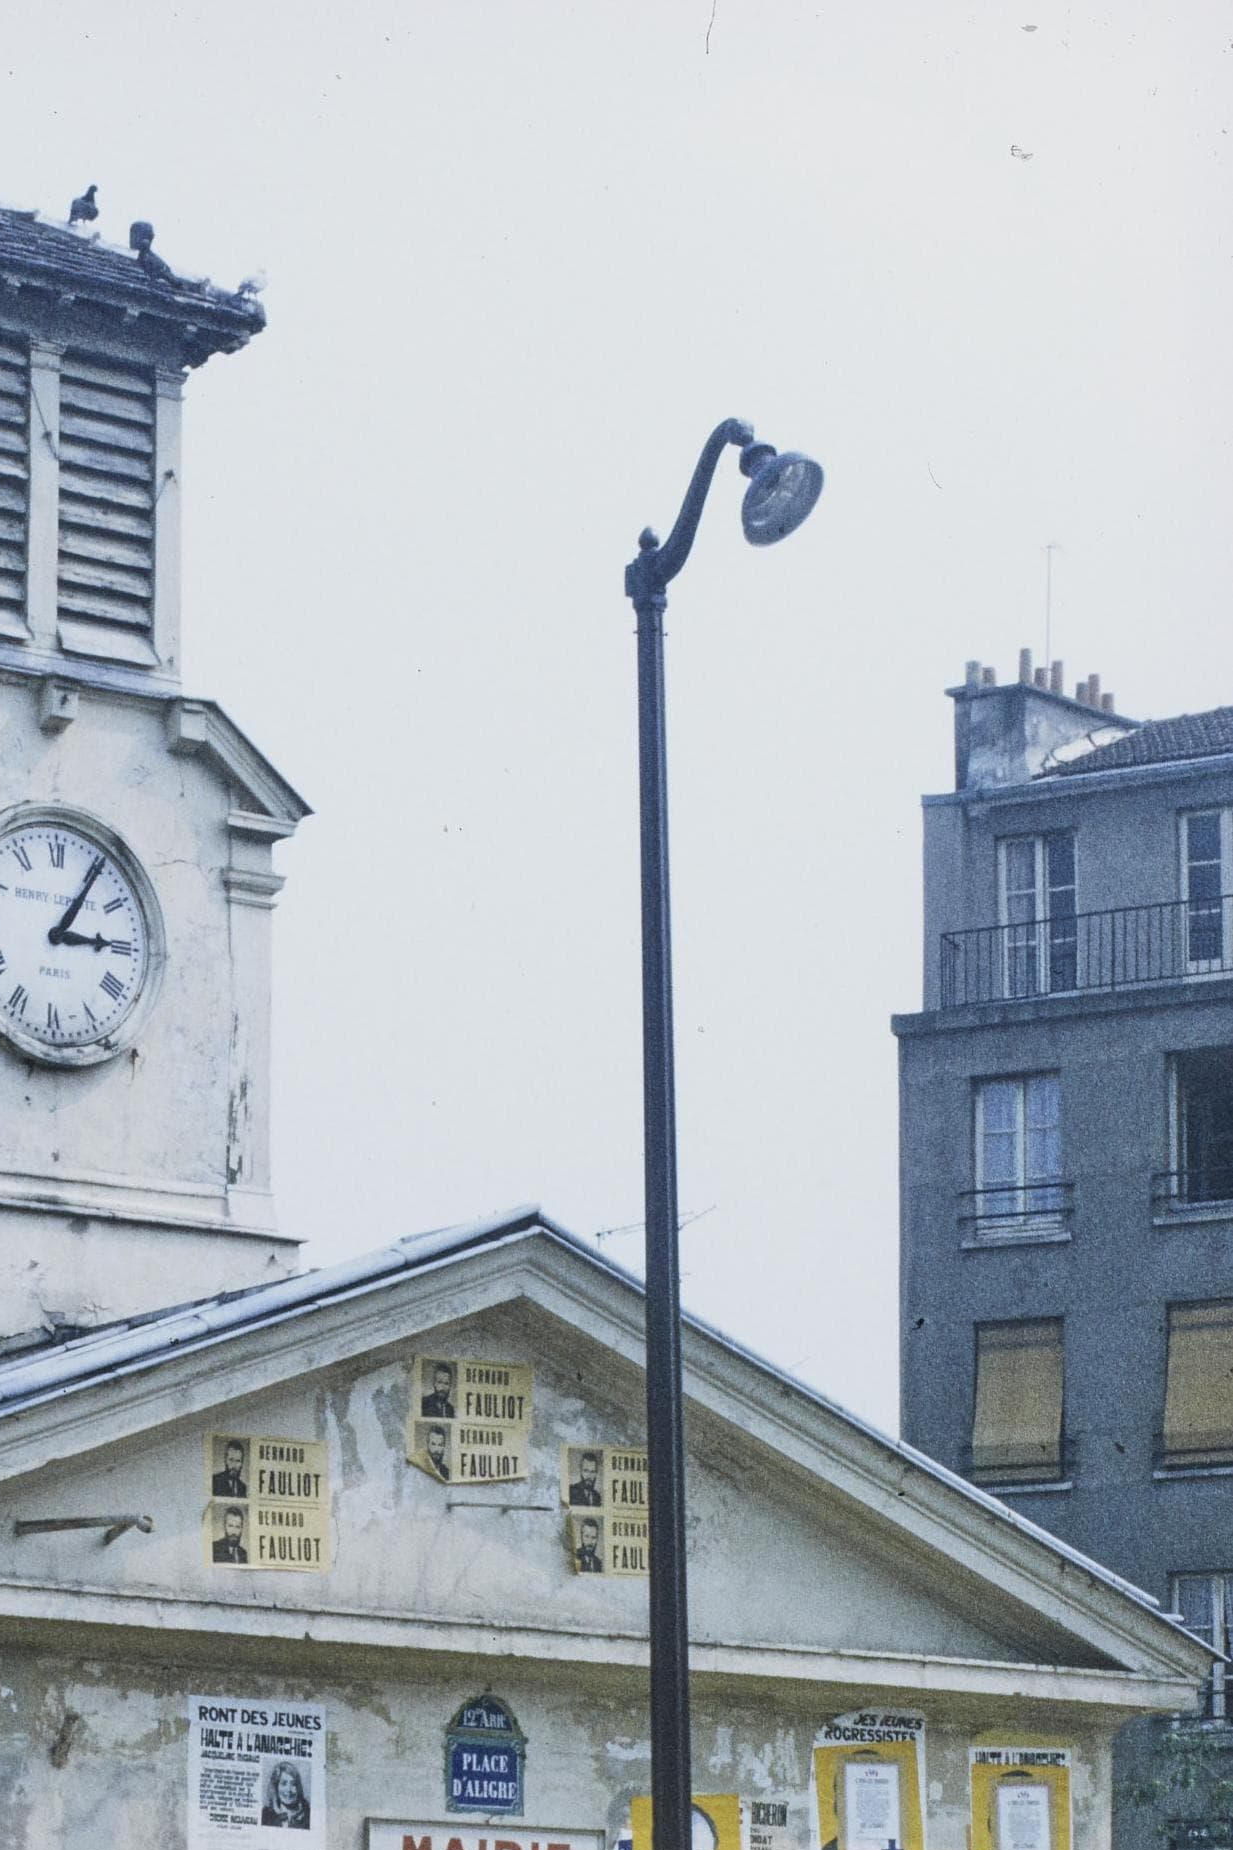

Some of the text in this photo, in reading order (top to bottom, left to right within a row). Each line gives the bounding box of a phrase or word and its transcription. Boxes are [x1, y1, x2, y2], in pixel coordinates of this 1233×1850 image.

[15, 887, 49, 902] HENRY
[39, 966, 71, 979] PARIS
[465, 1368, 509, 1386] BERNARD
[466, 1392, 524, 1420] FAULIOT
[460, 1429, 503, 1446] BERNARD
[259, 1445, 305, 1463] BERNARD
[612, 1456, 647, 1472] BERNAR
[461, 1453, 519, 1478] FAULIOT
[259, 1470, 321, 1497] FAULIOT
[612, 1480, 646, 1505] FAUL
[258, 1511, 304, 1527] BERNARD
[612, 1522, 647, 1538] BERNAR
[259, 1536, 320, 1562] FAULIOT
[612, 1549, 646, 1570] FAUL
[241, 1709, 268, 1726] DES
[272, 1712, 321, 1731] JEUNES
[462, 1753, 508, 1773] PLACE
[453, 1776, 517, 1800] D'ALIGRE
